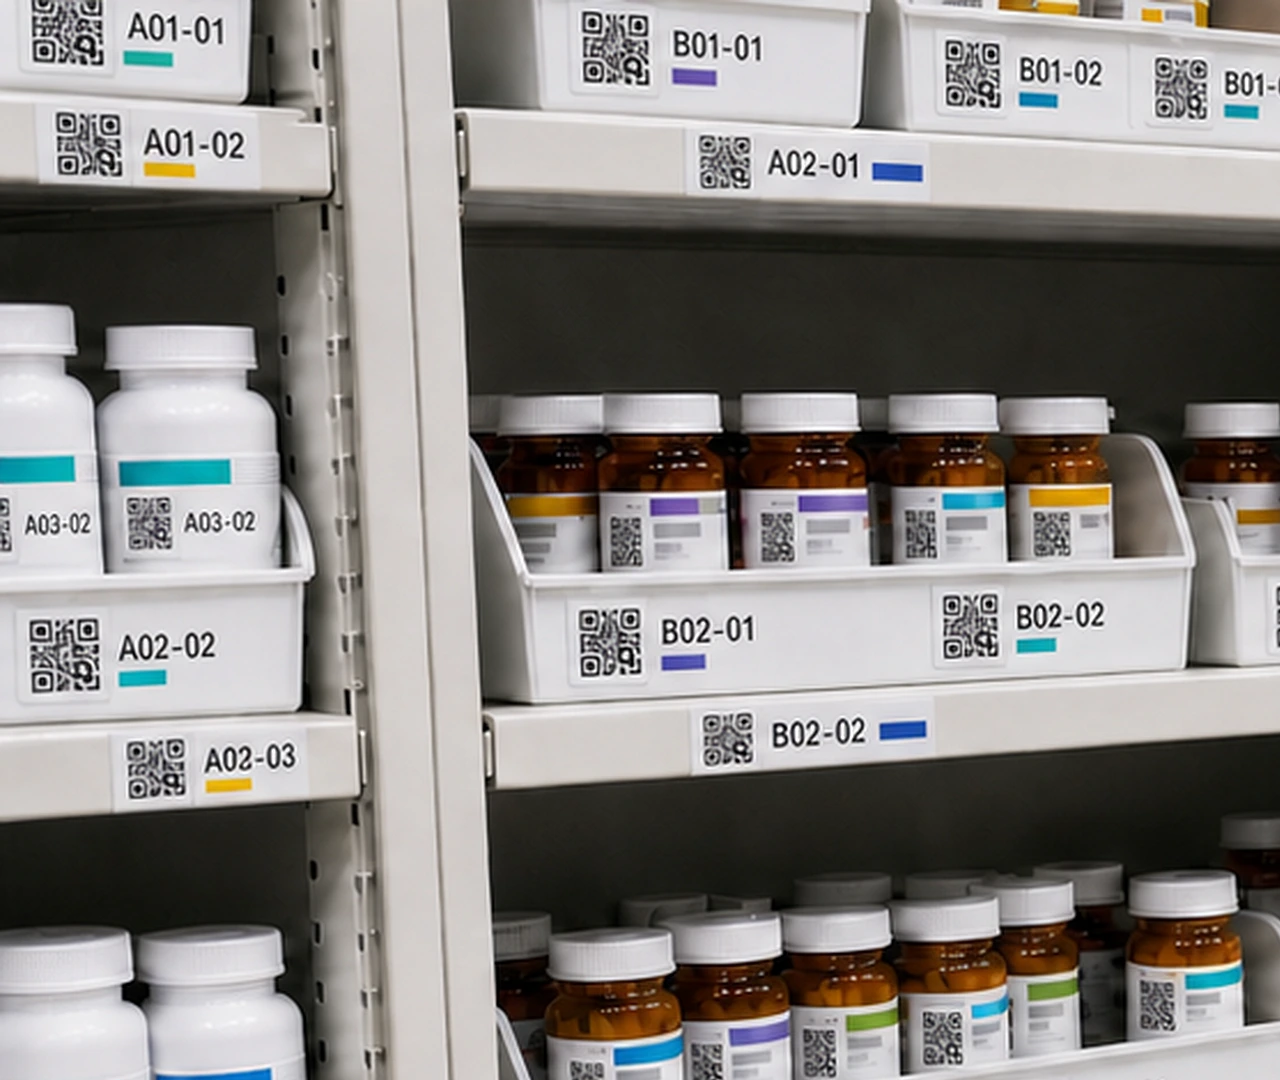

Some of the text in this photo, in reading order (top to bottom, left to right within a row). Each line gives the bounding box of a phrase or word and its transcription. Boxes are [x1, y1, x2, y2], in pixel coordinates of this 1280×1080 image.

[127, 12, 223, 45] A01-01
[673, 29, 761, 62] B01-01
[1020, 56, 1102, 87] B01-02
[143, 128, 245, 160] A01-02
[767, 149, 858, 179] A02-01
[24, 512, 91, 536] A03-02
[662, 615, 754, 645] B02-01
[1016, 601, 1105, 630] B02-02
[118, 631, 216, 662] A02-02
[772, 717, 866, 749] B02-02
